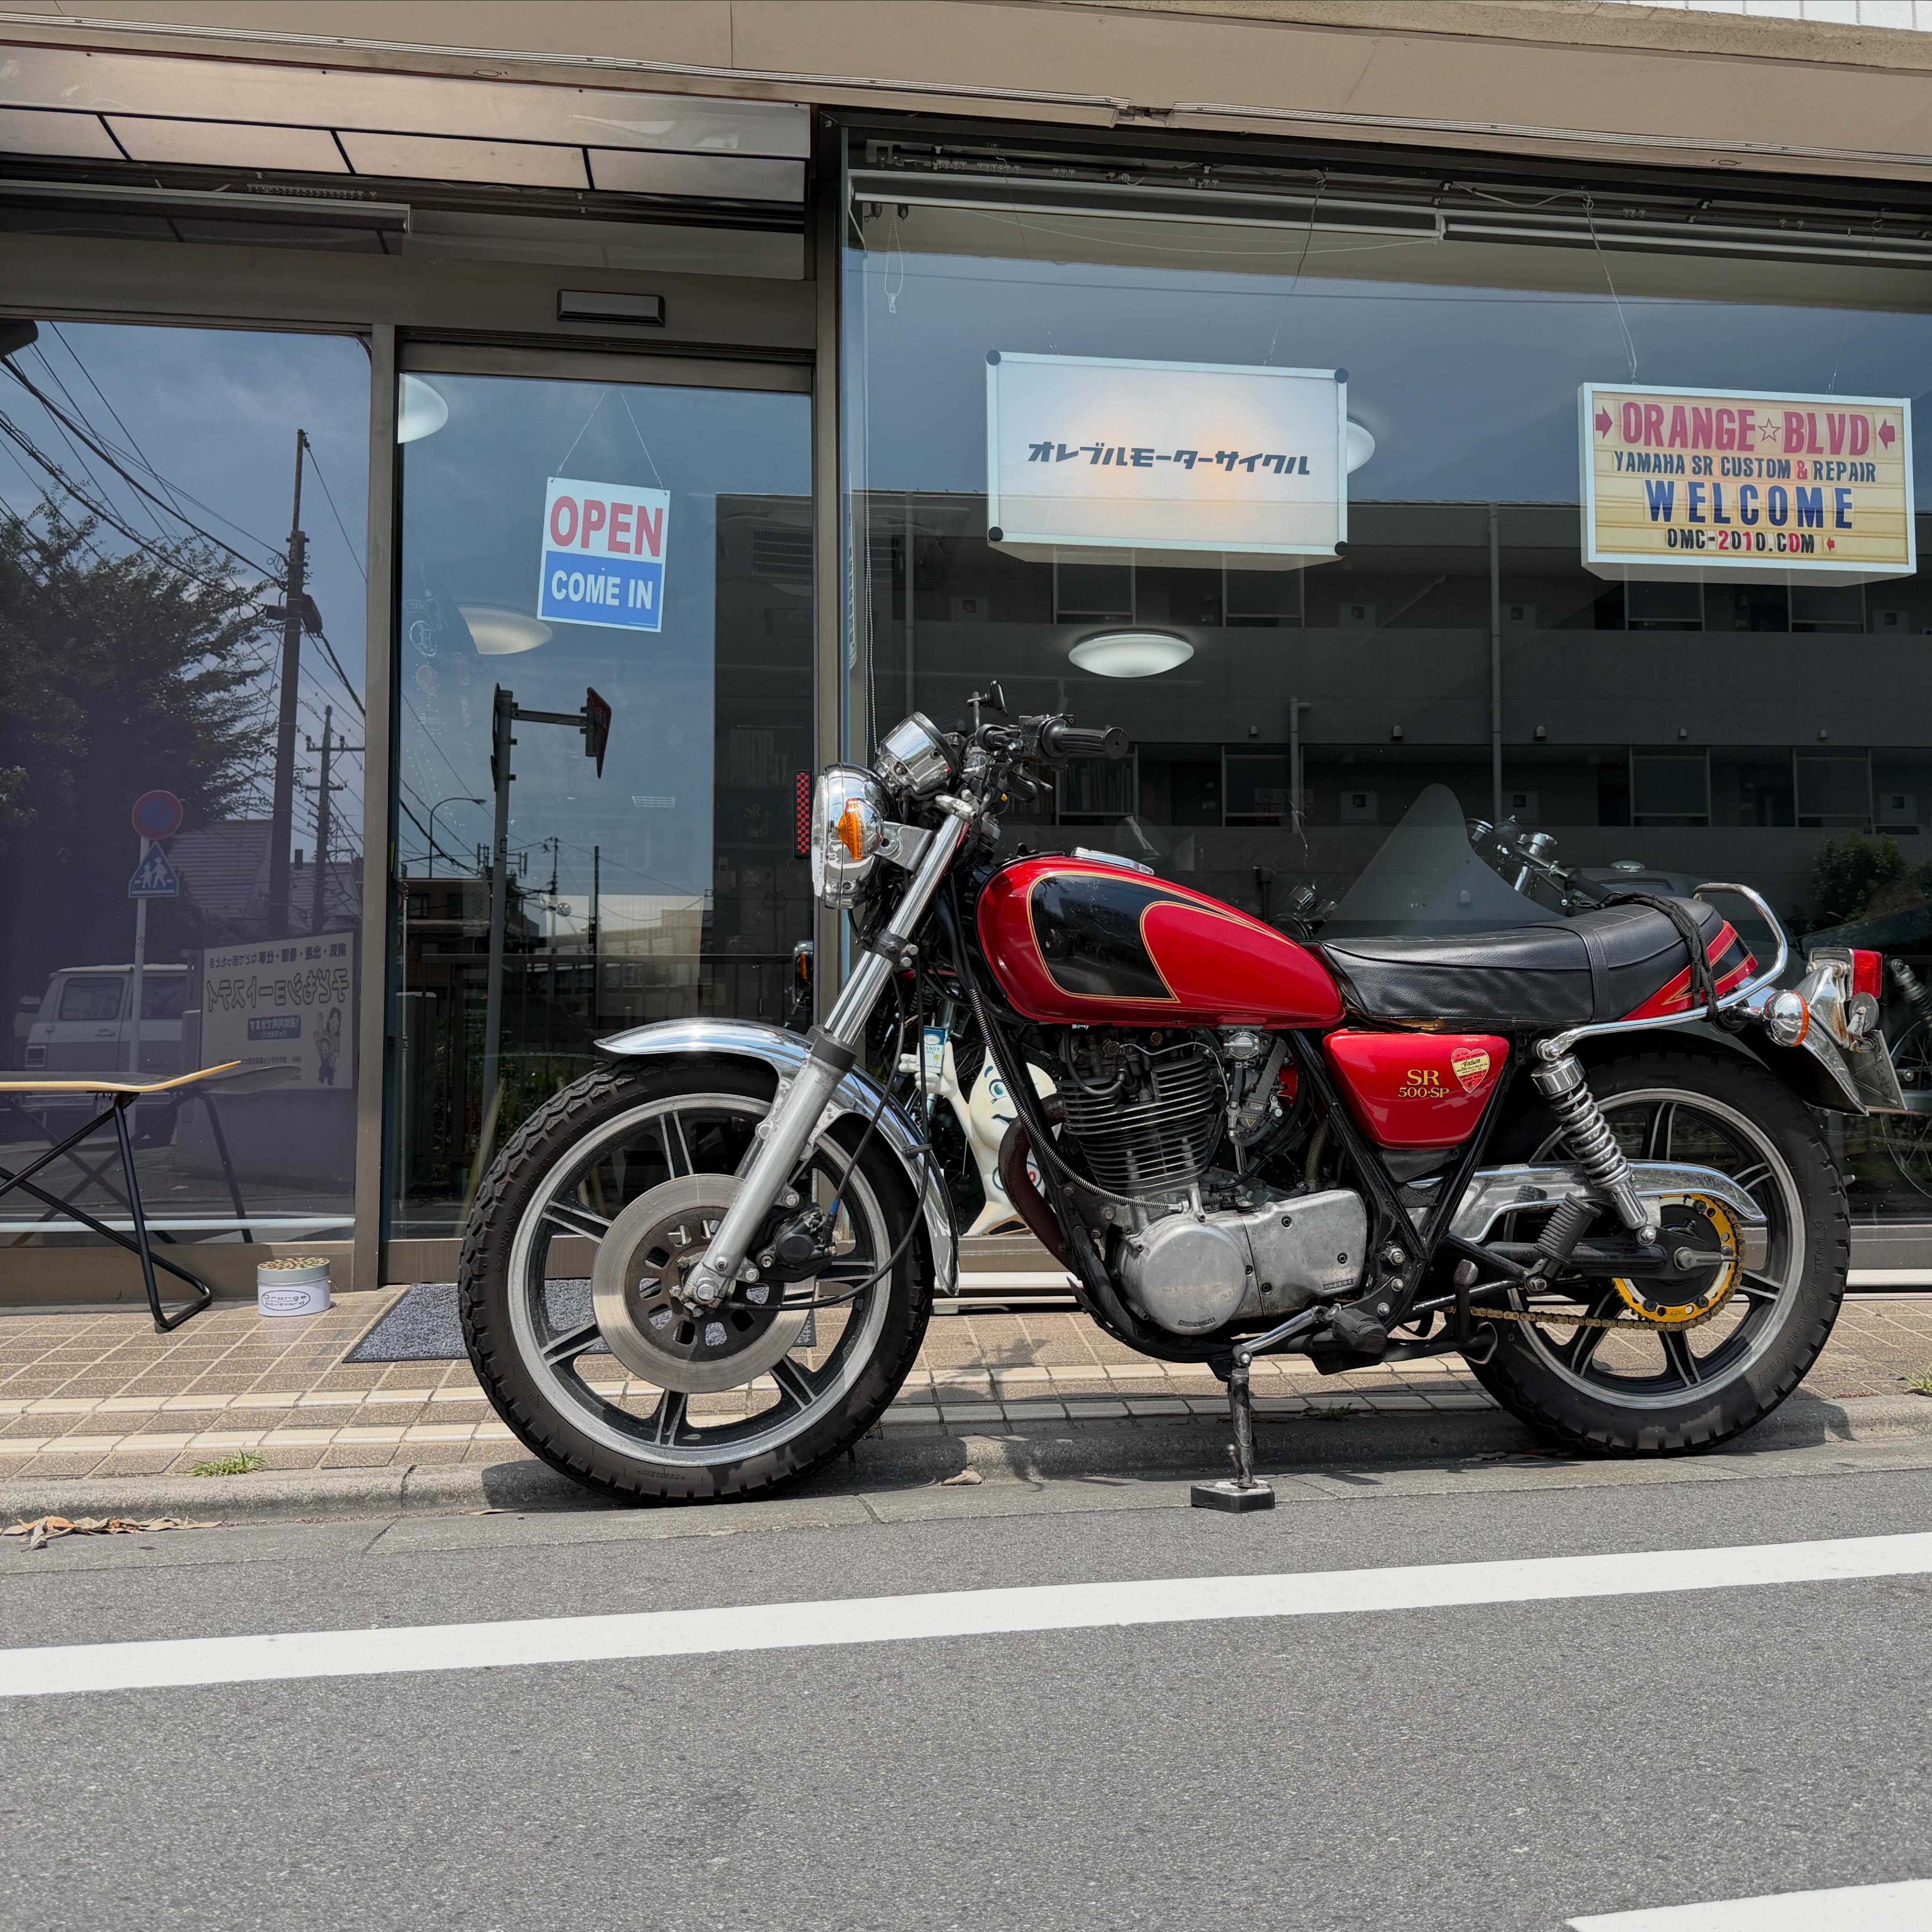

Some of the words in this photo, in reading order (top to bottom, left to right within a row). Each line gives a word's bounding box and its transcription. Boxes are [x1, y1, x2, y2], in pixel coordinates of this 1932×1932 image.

[1623, 401, 1756, 451] ORANGE
[1783, 411, 1870, 456] BLVD
[1028, 441, 1310, 475] オレブルモーターサイクル
[1614, 451, 1686, 475] YAMAHA
[1692, 456, 1713, 476] SR
[1721, 457, 1791, 479] CUSTOM
[1797, 460, 1808, 480] &
[1813, 461, 1876, 482] REPAIR
[1645, 480, 1852, 529] WELCOME
[550, 496, 664, 557] OPEN
[1667, 529, 1815, 554] OMC-2010.COM
[552, 570, 620, 606] COME
[628, 579, 653, 610] IN
[1398, 1087, 1449, 1098] 500-SP
[1407, 1069, 1440, 1086] SR
